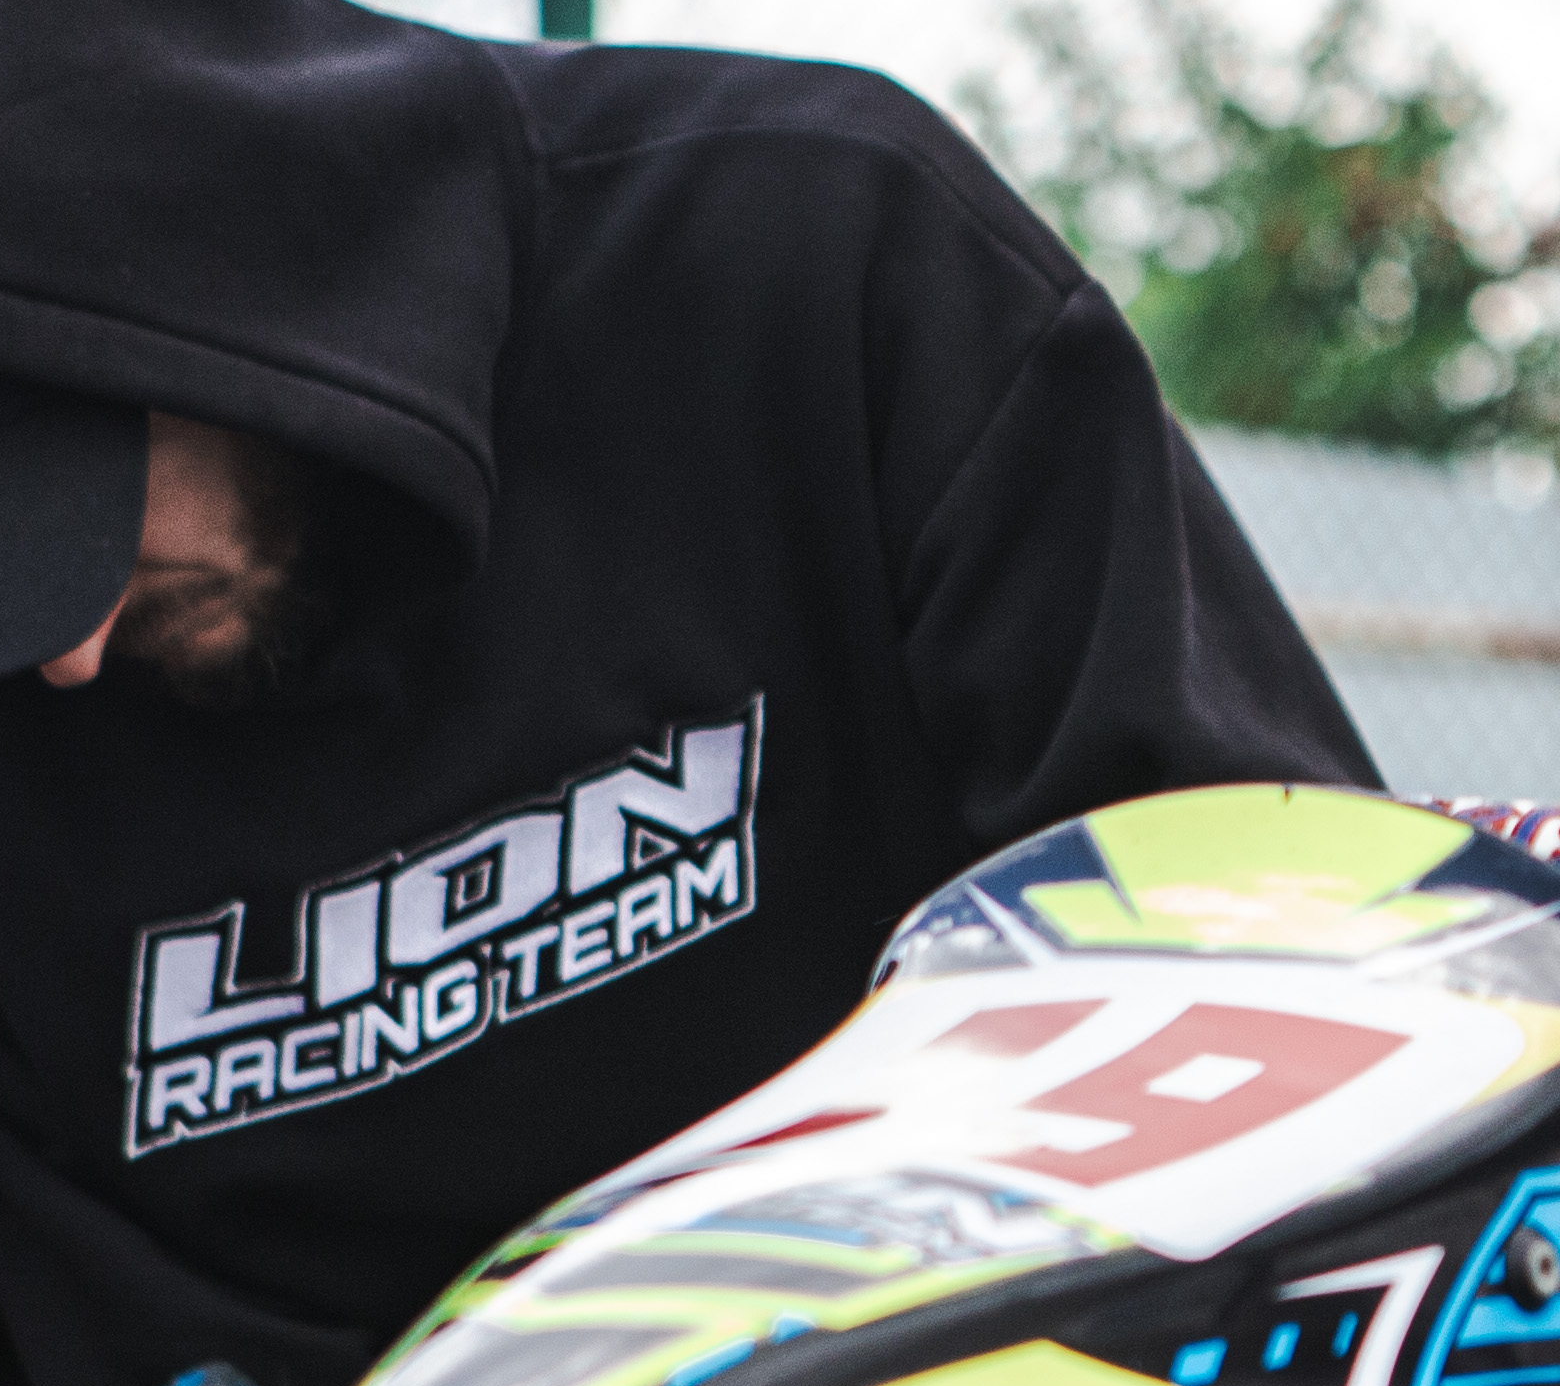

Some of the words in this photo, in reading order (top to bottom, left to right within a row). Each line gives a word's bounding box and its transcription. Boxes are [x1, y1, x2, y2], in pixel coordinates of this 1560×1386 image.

[148, 960, 478, 1129] RACING
[503, 838, 739, 1000] TEAM
[149, 724, 745, 1052] LION
